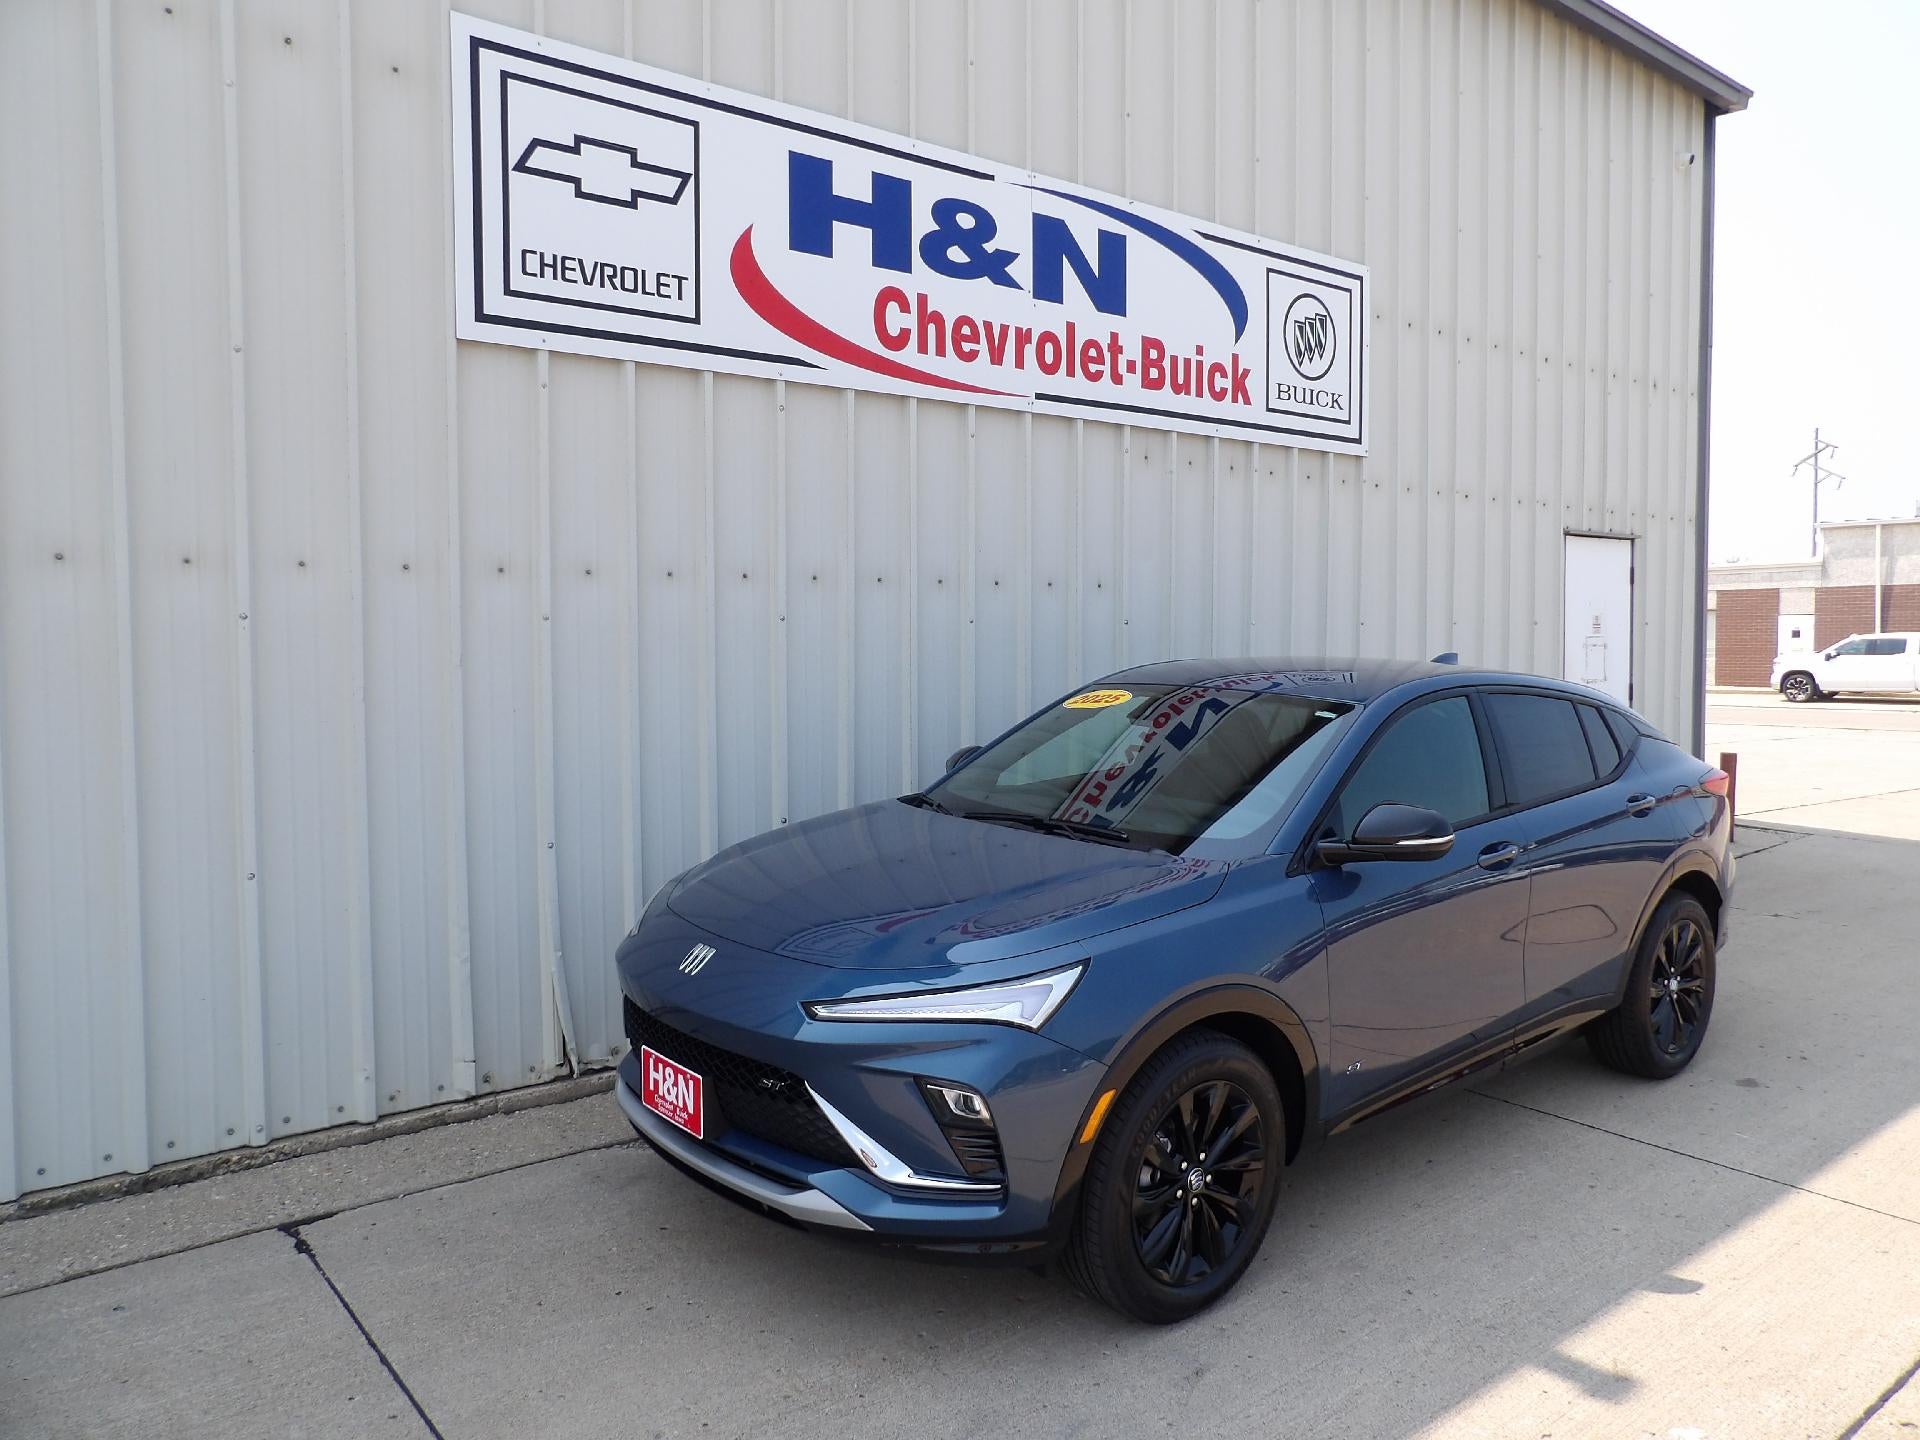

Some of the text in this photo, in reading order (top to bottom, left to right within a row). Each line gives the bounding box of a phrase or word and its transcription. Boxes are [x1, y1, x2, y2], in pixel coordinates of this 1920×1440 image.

[788, 150, 1127, 318] H&N
[521, 249, 689, 301] CHEVROLET
[873, 286, 1252, 406] Chevrolet-Buick
[1275, 382, 1345, 411] BUICK
[1066, 694, 1126, 704] 2025
[649, 1057, 694, 1115] H&N
